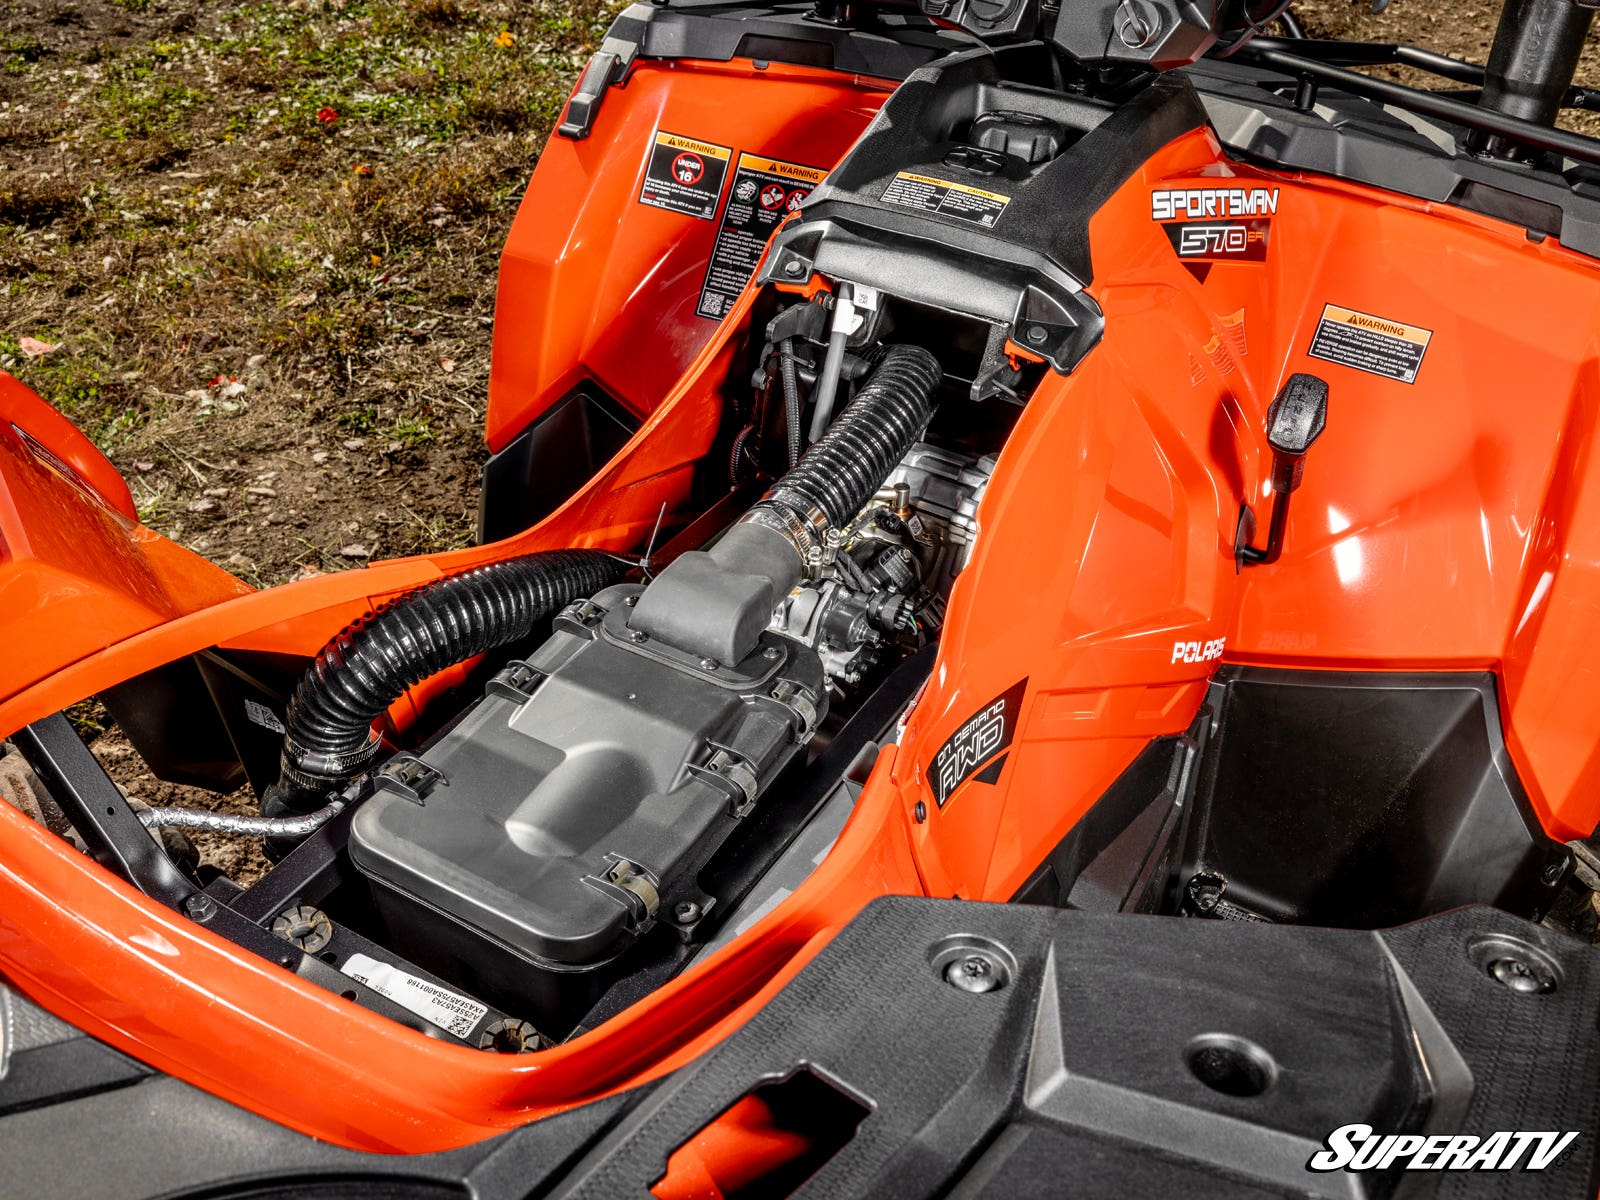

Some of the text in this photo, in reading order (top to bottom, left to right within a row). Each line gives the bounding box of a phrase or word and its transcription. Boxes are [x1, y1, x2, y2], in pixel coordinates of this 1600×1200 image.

[676, 139, 716, 154] WARNING
[677, 159, 700, 169] UNDER
[779, 165, 819, 179] WARNING
[677, 170, 692, 181] 16
[967, 188, 994, 199] CAUTION
[1152, 188, 1279, 220] SPORTSMAN
[1180, 226, 1246, 254] 570
[1357, 318, 1405, 335] WARNING
[1171, 637, 1226, 664] POLARIS
[938, 699, 1005, 765] ON DEMAND
[938, 714, 1004, 806] AWD
